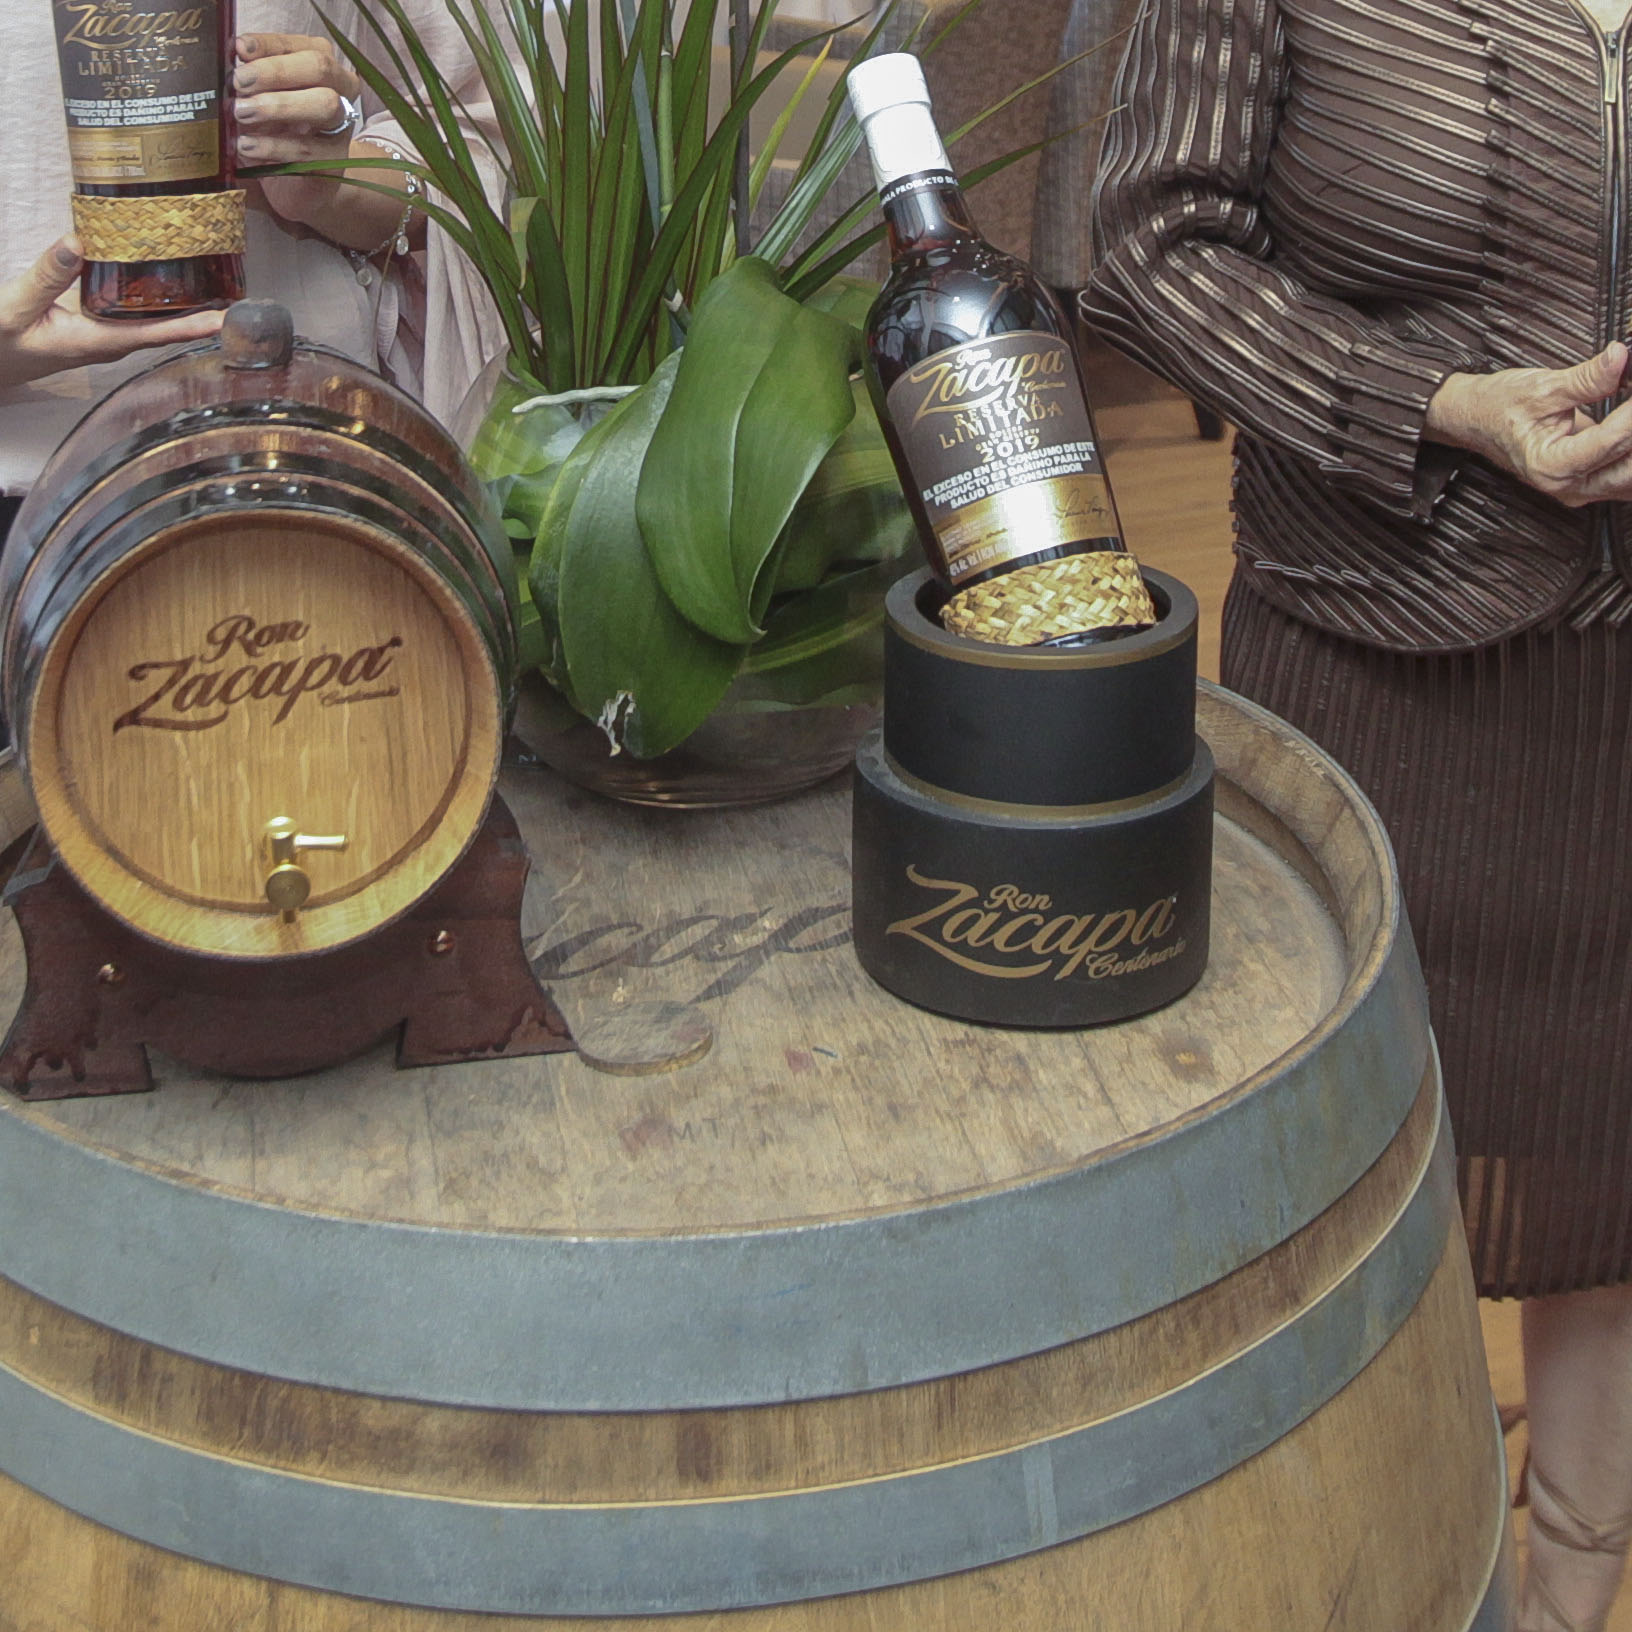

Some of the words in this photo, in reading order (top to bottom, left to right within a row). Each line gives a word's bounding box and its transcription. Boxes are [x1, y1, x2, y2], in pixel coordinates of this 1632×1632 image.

[64, 3, 205, 51] Zacapa
[104, 84, 158, 99] 2019
[125, 95, 178, 109] CONSUMO
[179, 93, 193, 104] DE
[166, 103, 194, 114] PARA
[194, 101, 208, 111] LA
[895, 175, 944, 195] PRODUCTO
[910, 350, 1065, 430] Zacapa
[939, 400, 1064, 450] LIMITADA
[979, 435, 1040, 463] 2019
[933, 471, 973, 495] EXCESO
[973, 464, 991, 478] EN
[990, 459, 1008, 471] EL
[1006, 446, 1063, 466] CONSUMO
[1063, 442, 1078, 453] DE
[934, 476, 990, 507] PRODUCTO
[991, 470, 1007, 482] ES
[1054, 453, 1081, 466] PARA
[1079, 451, 1092, 462] LA
[950, 488, 986, 510] SALUD
[987, 481, 1010, 496] DEL
[1010, 462, 1084, 487] CONSUMIDOR
[199, 614, 311, 664] Ron
[112, 635, 404, 736] Zacapa
[983, 883, 1053, 913] Ron
[885, 864, 1178, 981] Zacapa
[1085, 936, 1187, 980] Centenario
